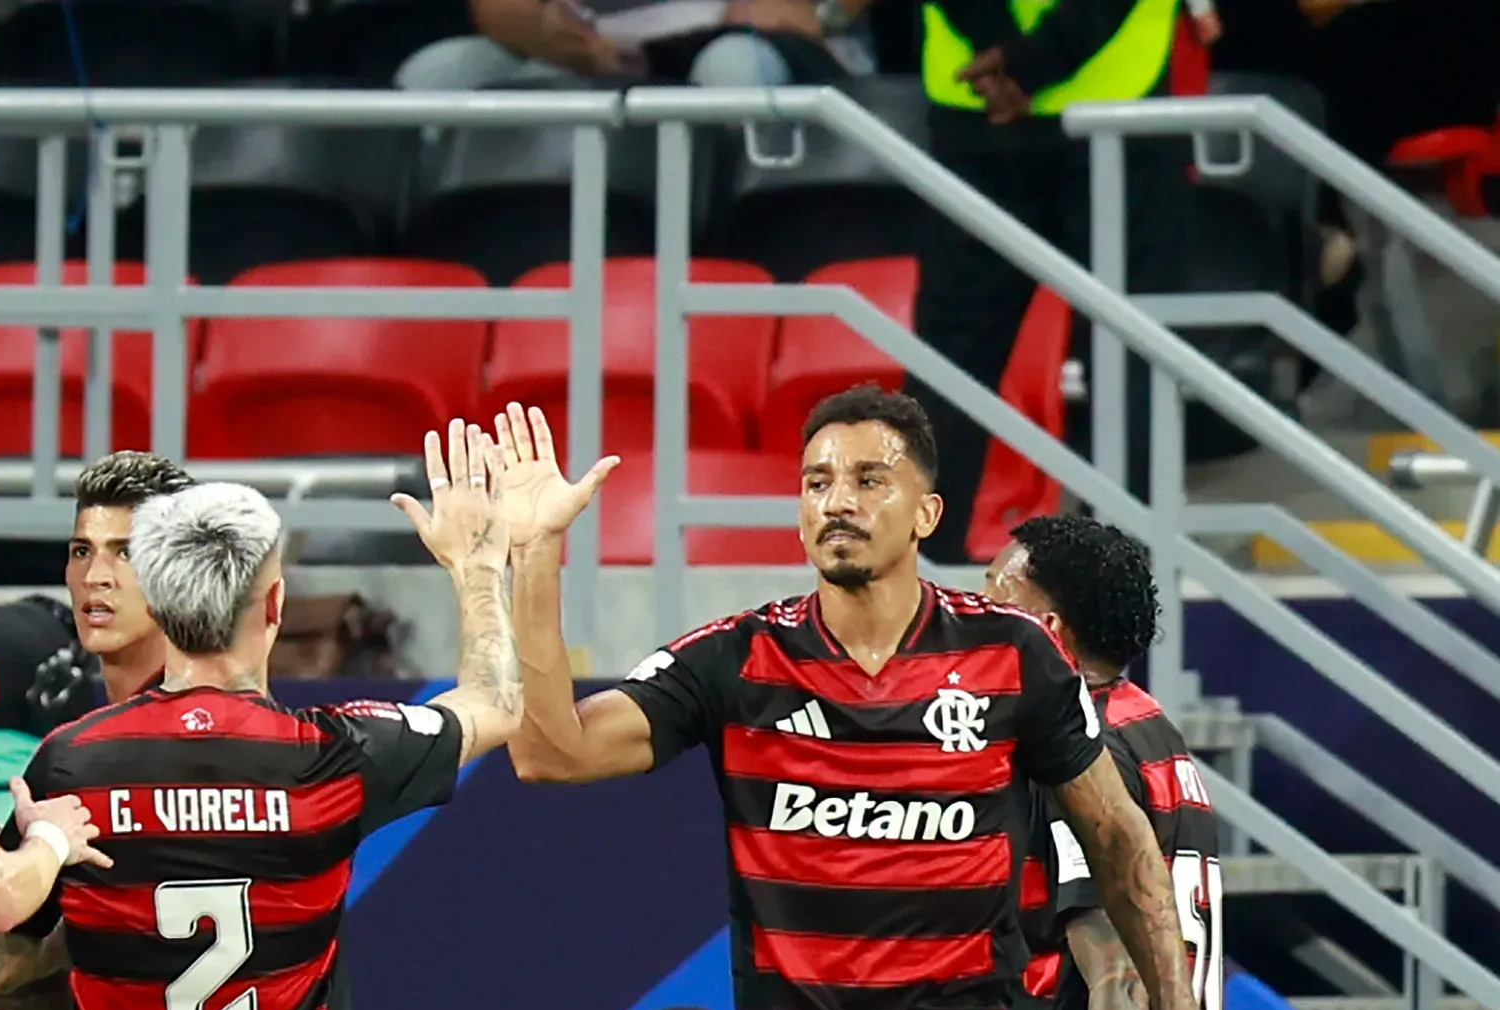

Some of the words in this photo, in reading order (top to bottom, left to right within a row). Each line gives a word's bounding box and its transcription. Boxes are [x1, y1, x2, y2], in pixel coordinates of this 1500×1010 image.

[109, 788, 143, 833] G.
[153, 788, 291, 832] VARELA
[769, 782, 976, 841] Betano
